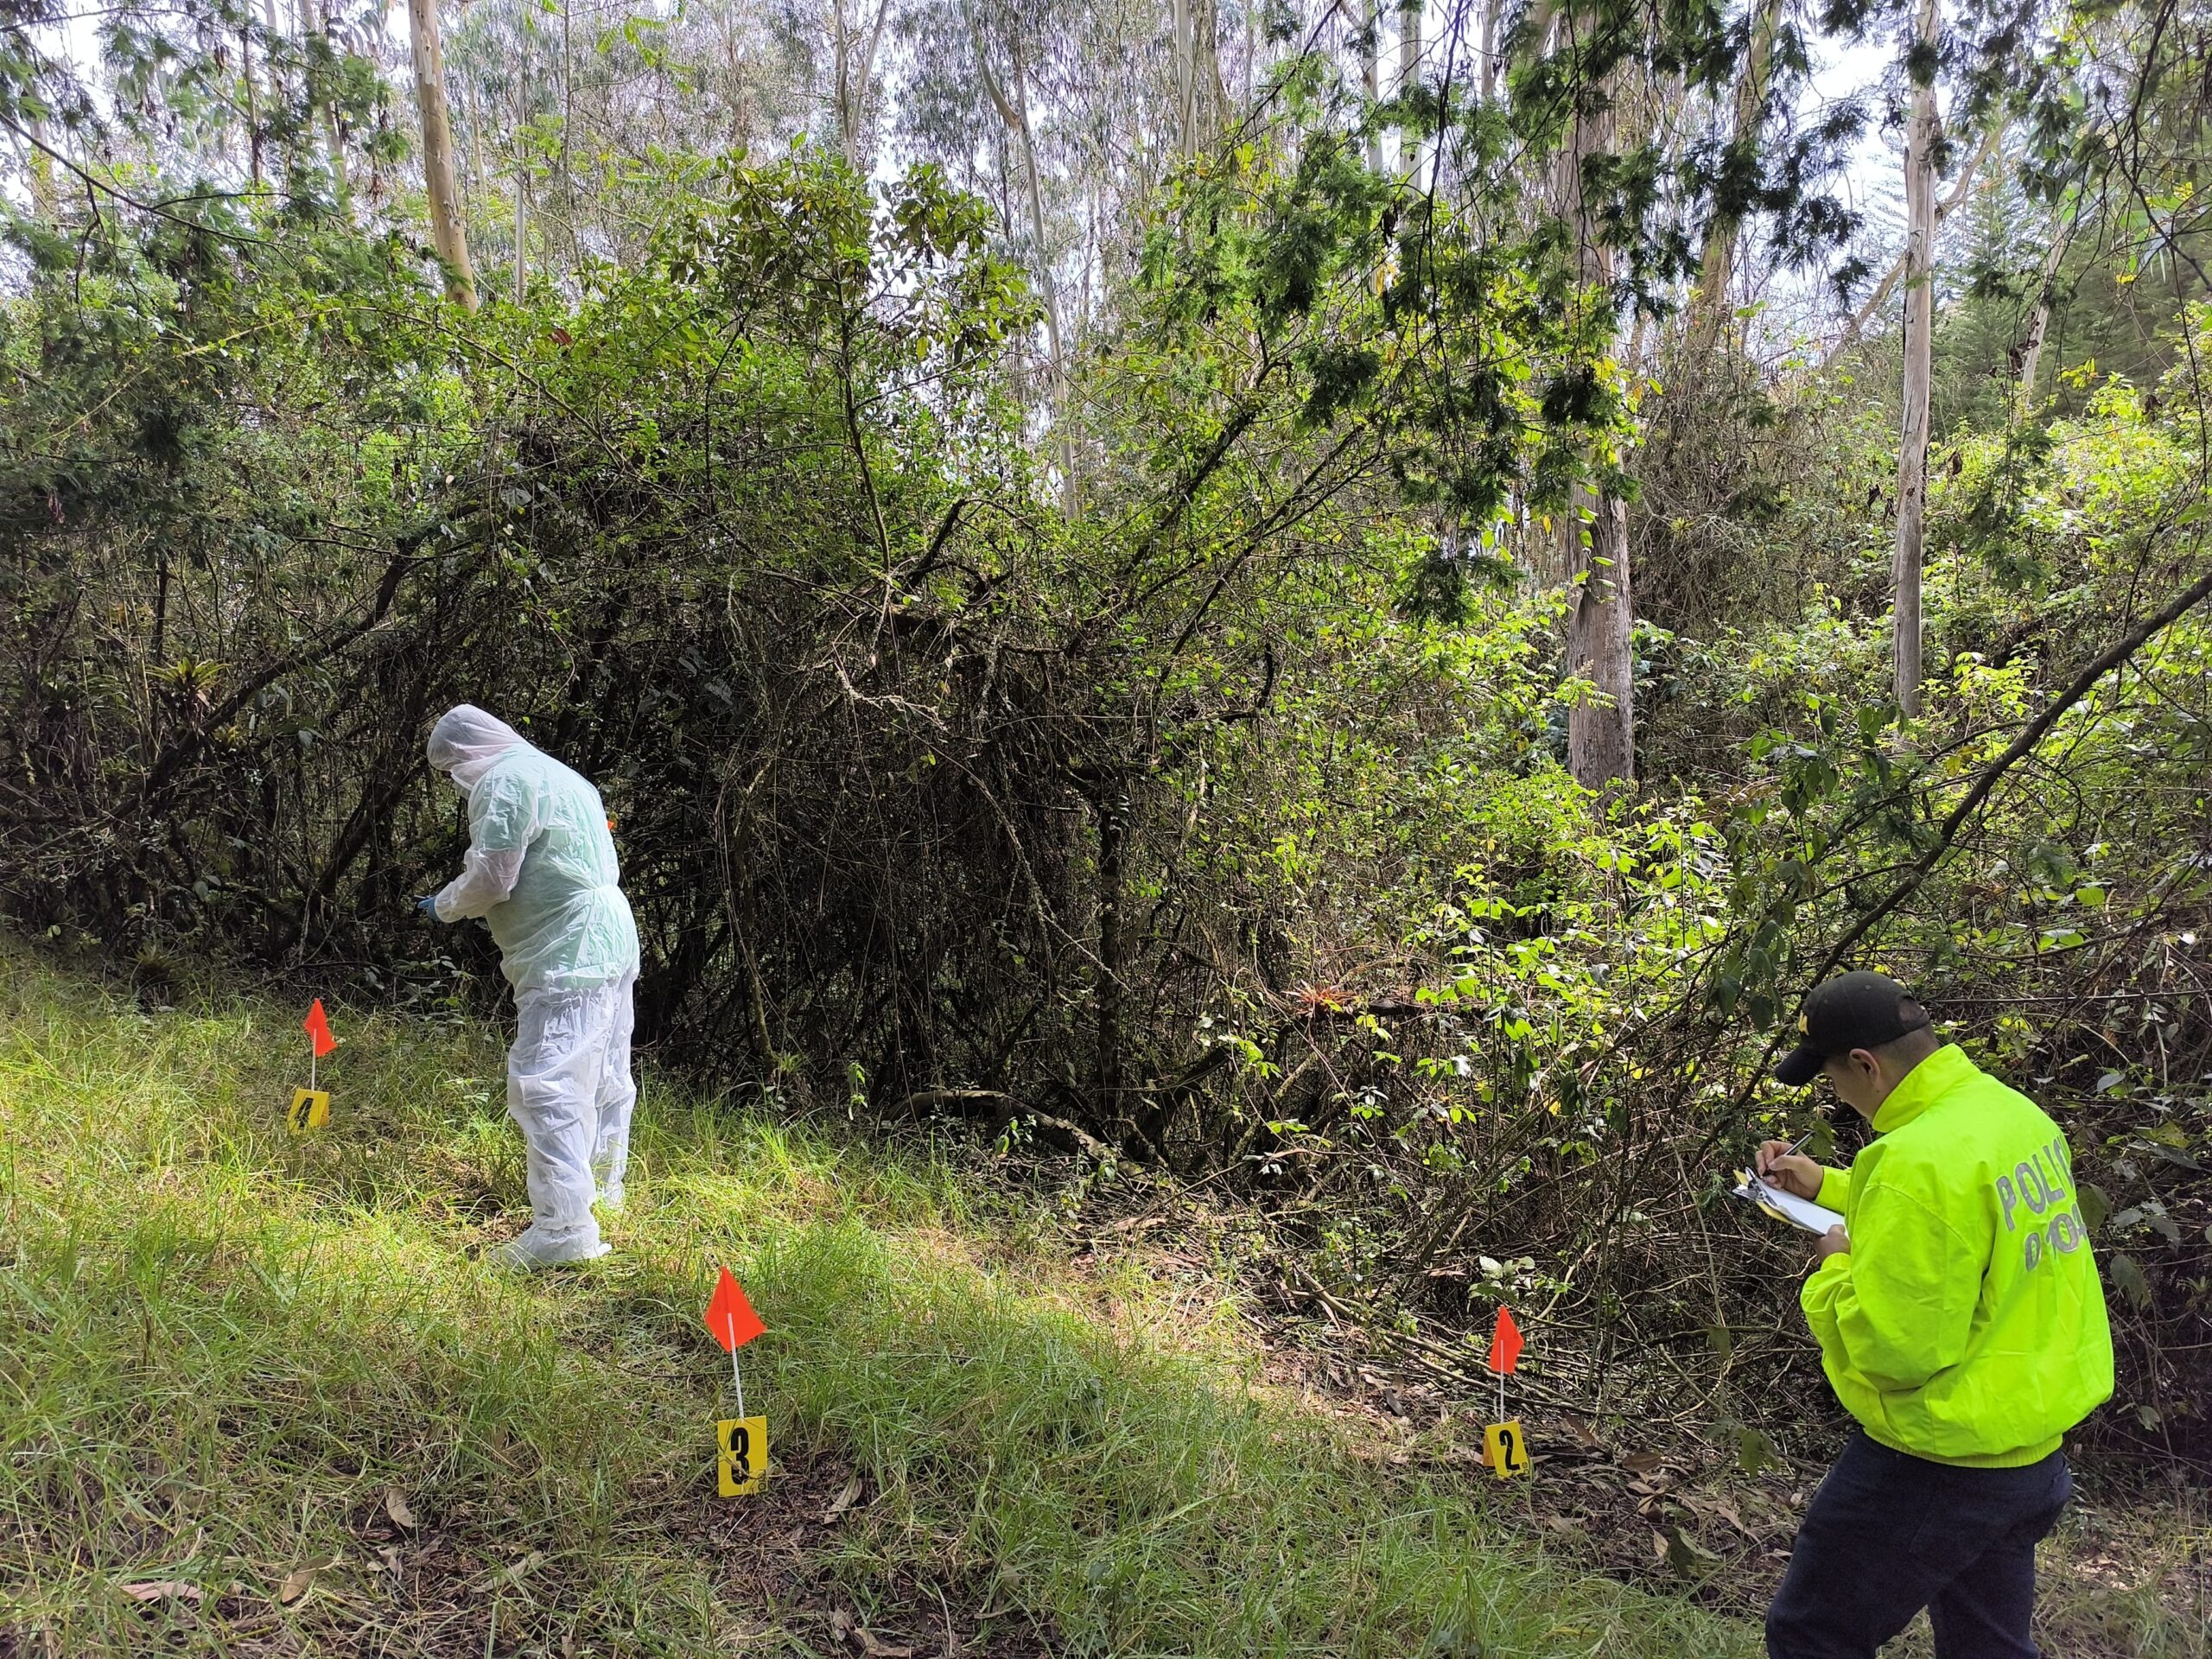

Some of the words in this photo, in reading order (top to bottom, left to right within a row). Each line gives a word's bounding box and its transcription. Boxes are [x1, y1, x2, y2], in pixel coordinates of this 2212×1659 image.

[295, 1097, 314, 1129] 4
[1996, 1135, 2074, 1230] POLIC
[731, 1427, 749, 1484] 3
[1499, 1430, 1520, 1470] 2
